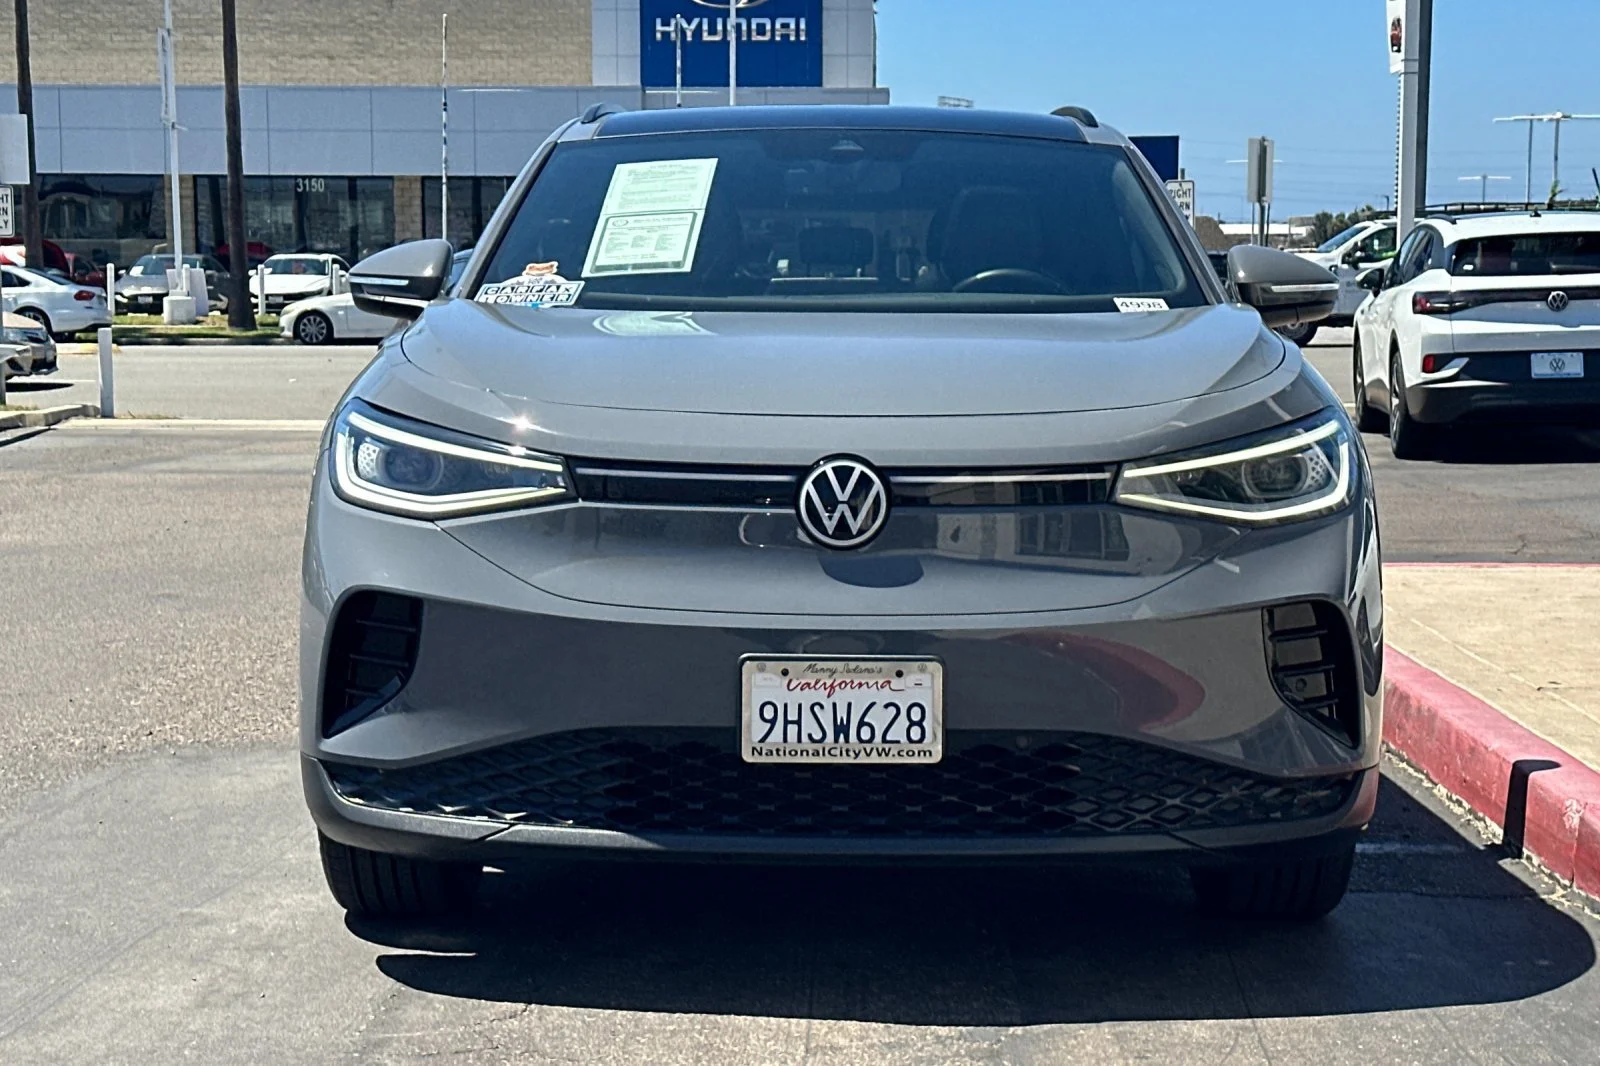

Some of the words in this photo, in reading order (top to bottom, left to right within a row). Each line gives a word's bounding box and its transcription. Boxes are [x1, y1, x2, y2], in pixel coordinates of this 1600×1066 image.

[655, 17, 807, 42] HYUNDAI
[296, 177, 325, 192] 3150
[483, 285, 574, 295] CARFAX
[496, 293, 572, 304] OWNER
[1120, 301, 1163, 309] 4998
[786, 678, 905, 699] California
[758, 700, 927, 745] 9HSW628
[751, 746, 933, 760] NationalCityVW.com
